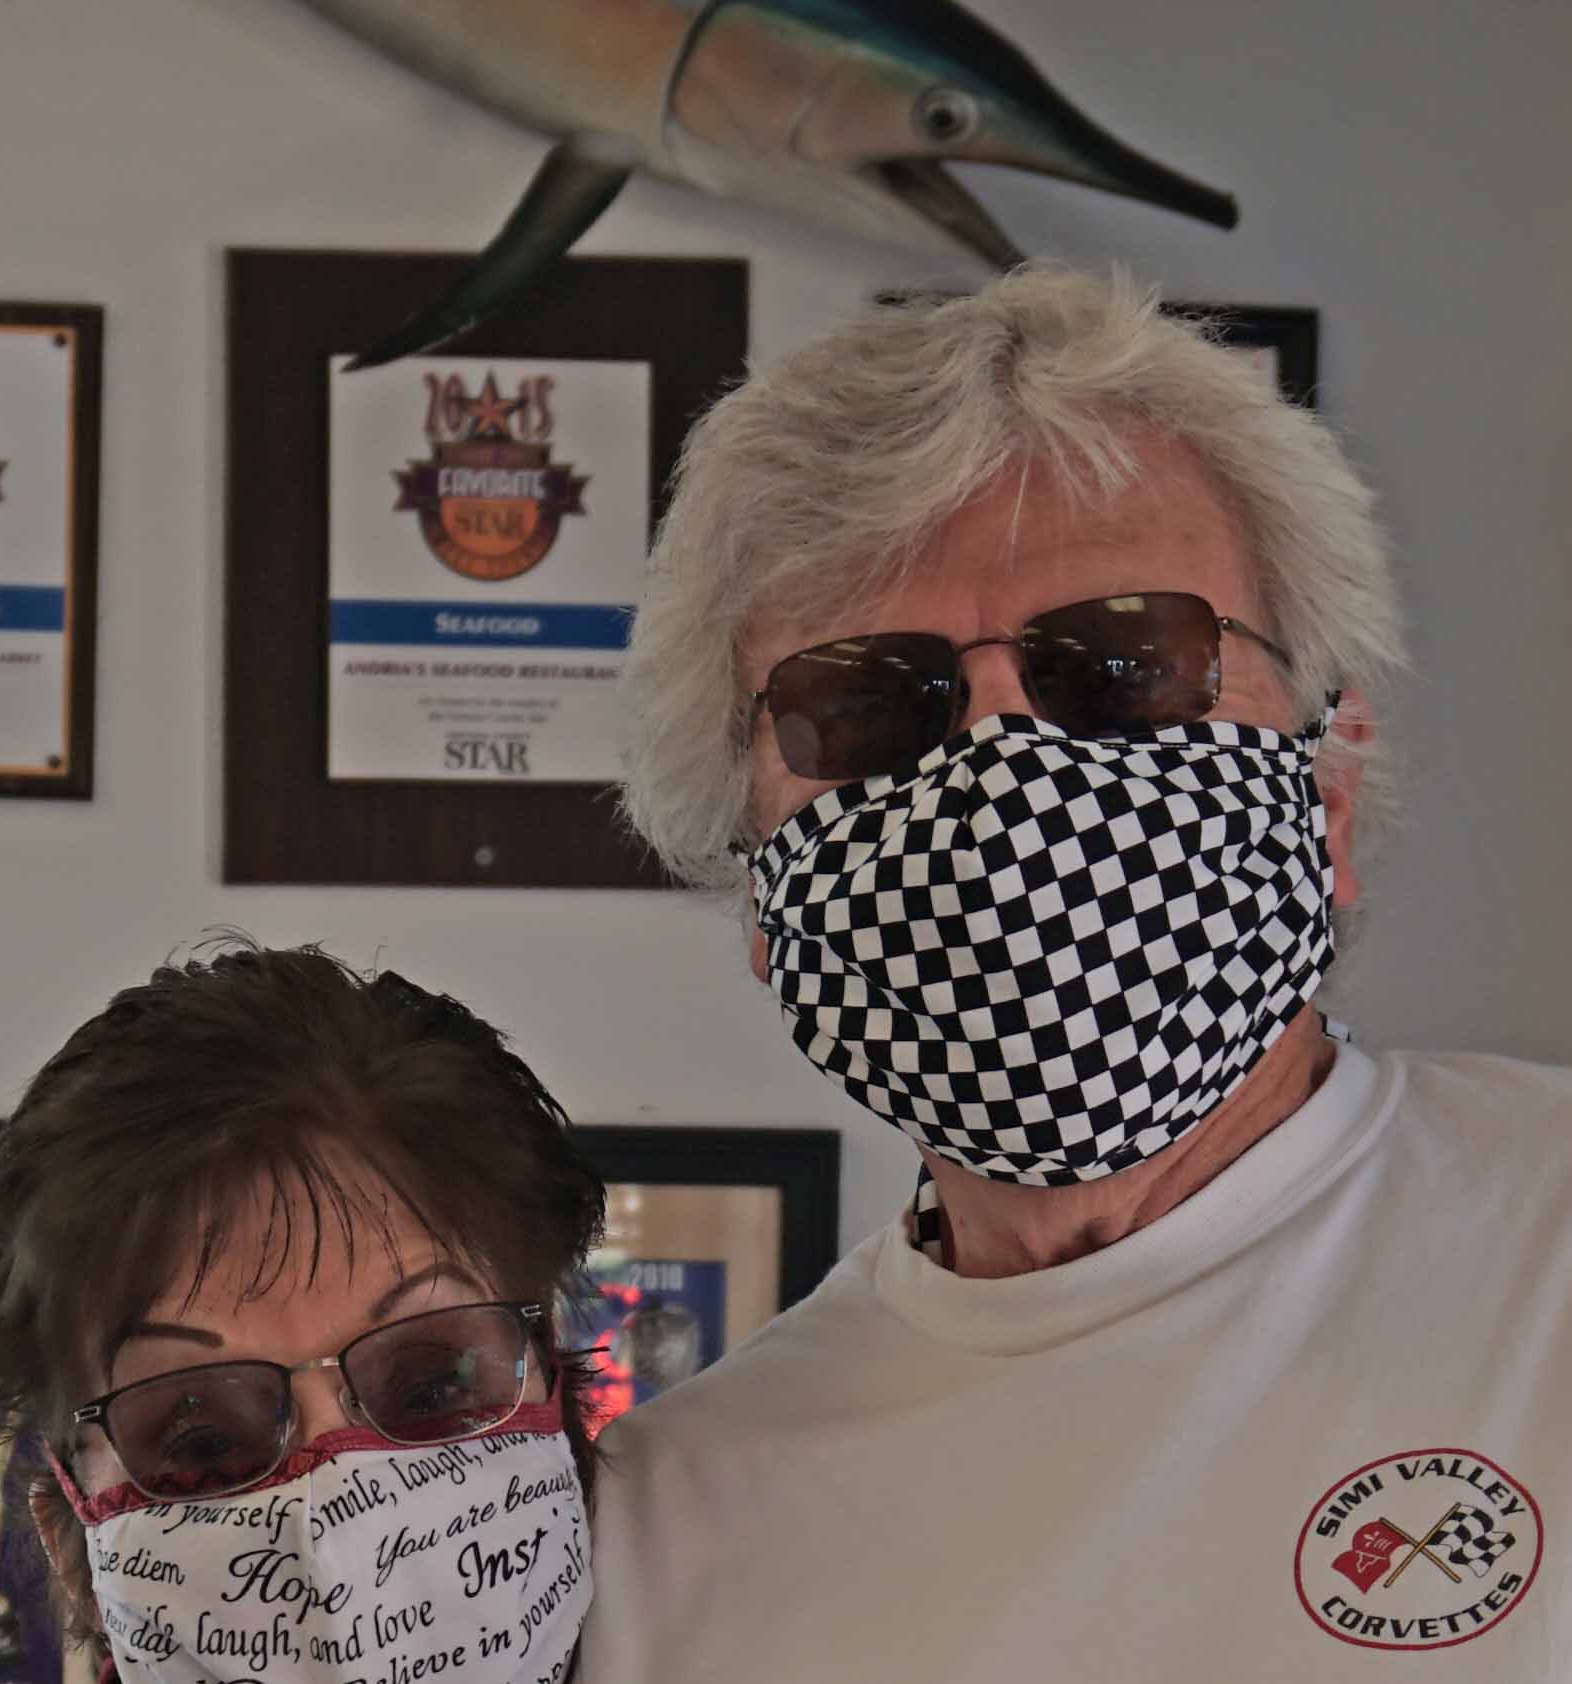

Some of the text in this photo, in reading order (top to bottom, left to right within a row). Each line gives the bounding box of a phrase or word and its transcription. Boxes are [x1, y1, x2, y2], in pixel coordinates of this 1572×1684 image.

[436, 611, 541, 637] SEAFOOD
[444, 739, 530, 774] STAR
[388, 1444, 484, 1492] laugh,
[1316, 1458, 1527, 1538] SIMI VALLEY
[122, 1548, 186, 1586] diem
[375, 1525, 440, 1588] You
[446, 1501, 498, 1537] are
[220, 1549, 354, 1624] Hope
[478, 1627, 513, 1659] in
[519, 1530, 586, 1658] yourself
[1320, 1571, 1524, 1639] CORVETTES
[196, 1611, 301, 1672] laugh,
[310, 1624, 363, 1666] and
[375, 1599, 436, 1649] love
